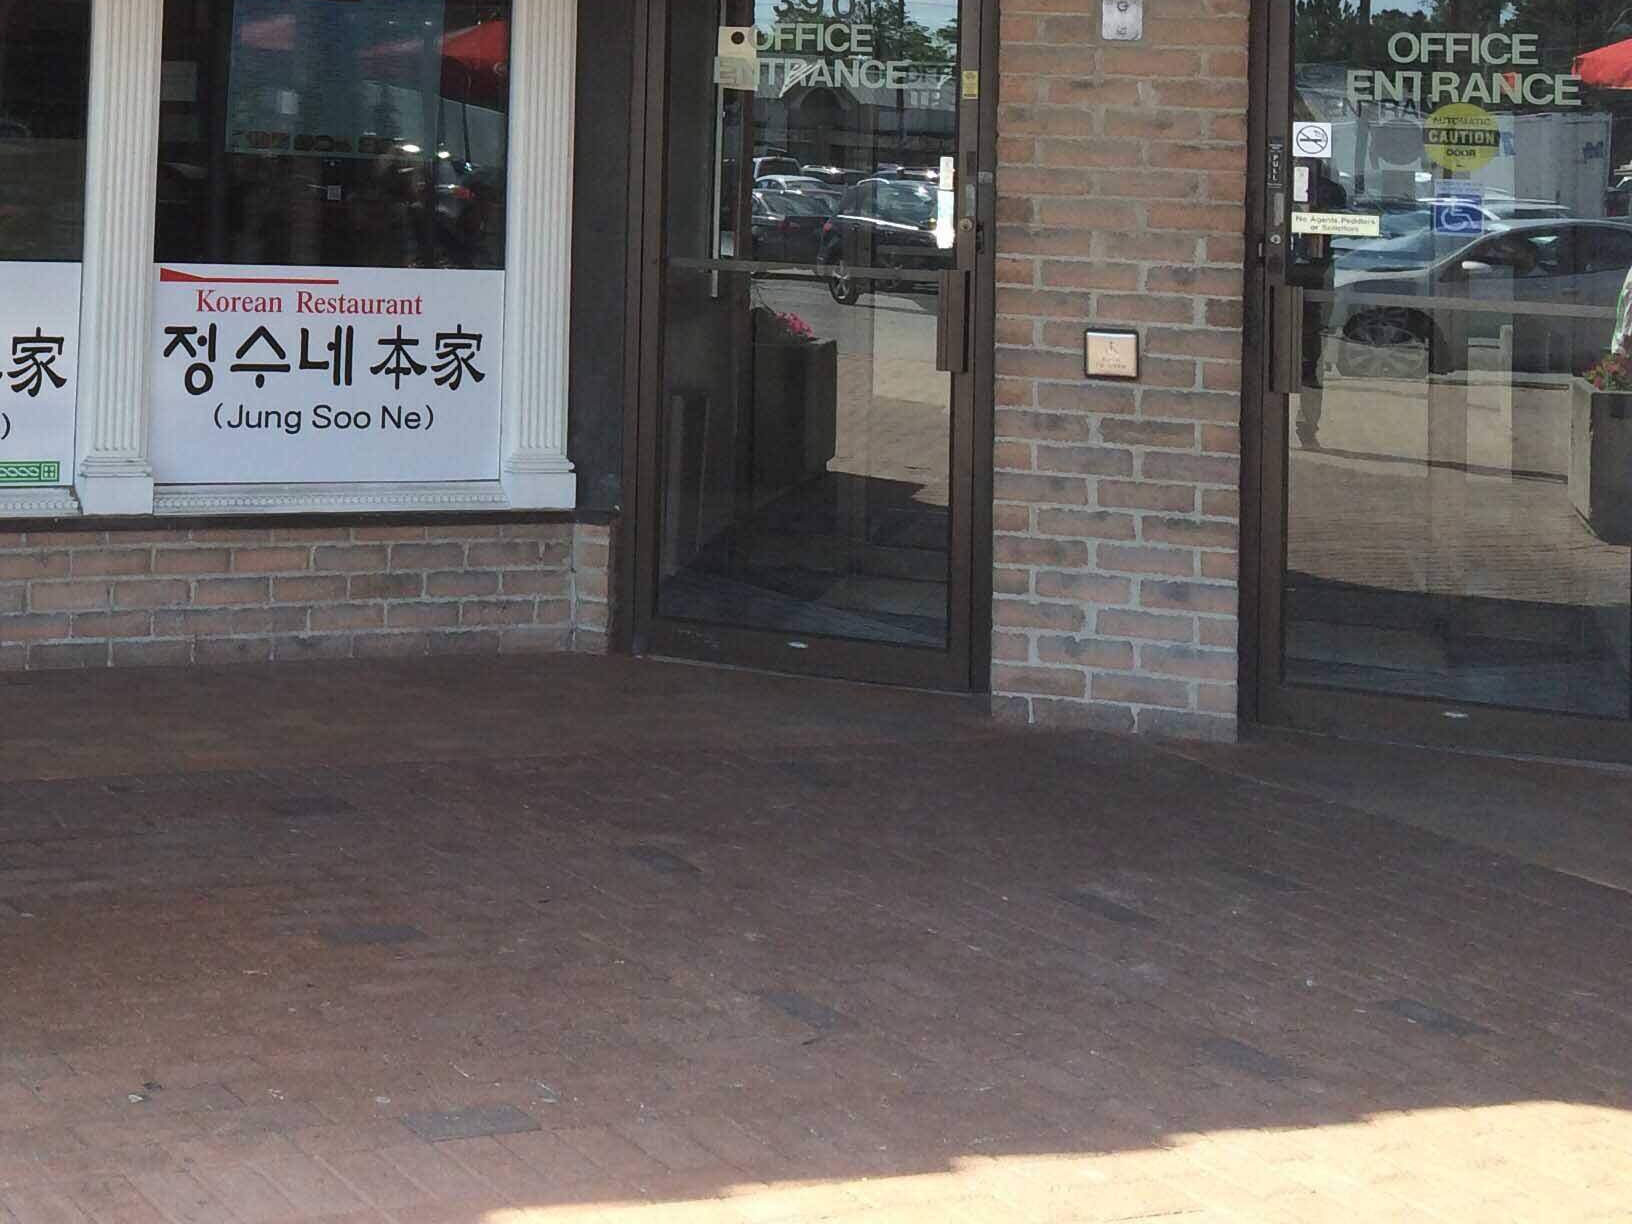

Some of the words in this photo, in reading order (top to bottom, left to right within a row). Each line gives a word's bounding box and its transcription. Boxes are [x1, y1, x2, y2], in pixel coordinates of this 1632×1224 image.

[749, 22, 874, 54] OFFICE
[1387, 31, 1539, 66] OFFICE
[713, 55, 911, 90] ENTRANCE
[1346, 70, 1582, 106] ENTRANCE
[1428, 129, 1495, 145] CAUTION
[195, 288, 283, 314] Korean
[295, 290, 424, 316] Restaurant
[213, 402, 302, 435] (Jung
[311, 403, 372, 431] Soo
[380, 403, 435, 431] Ne)
